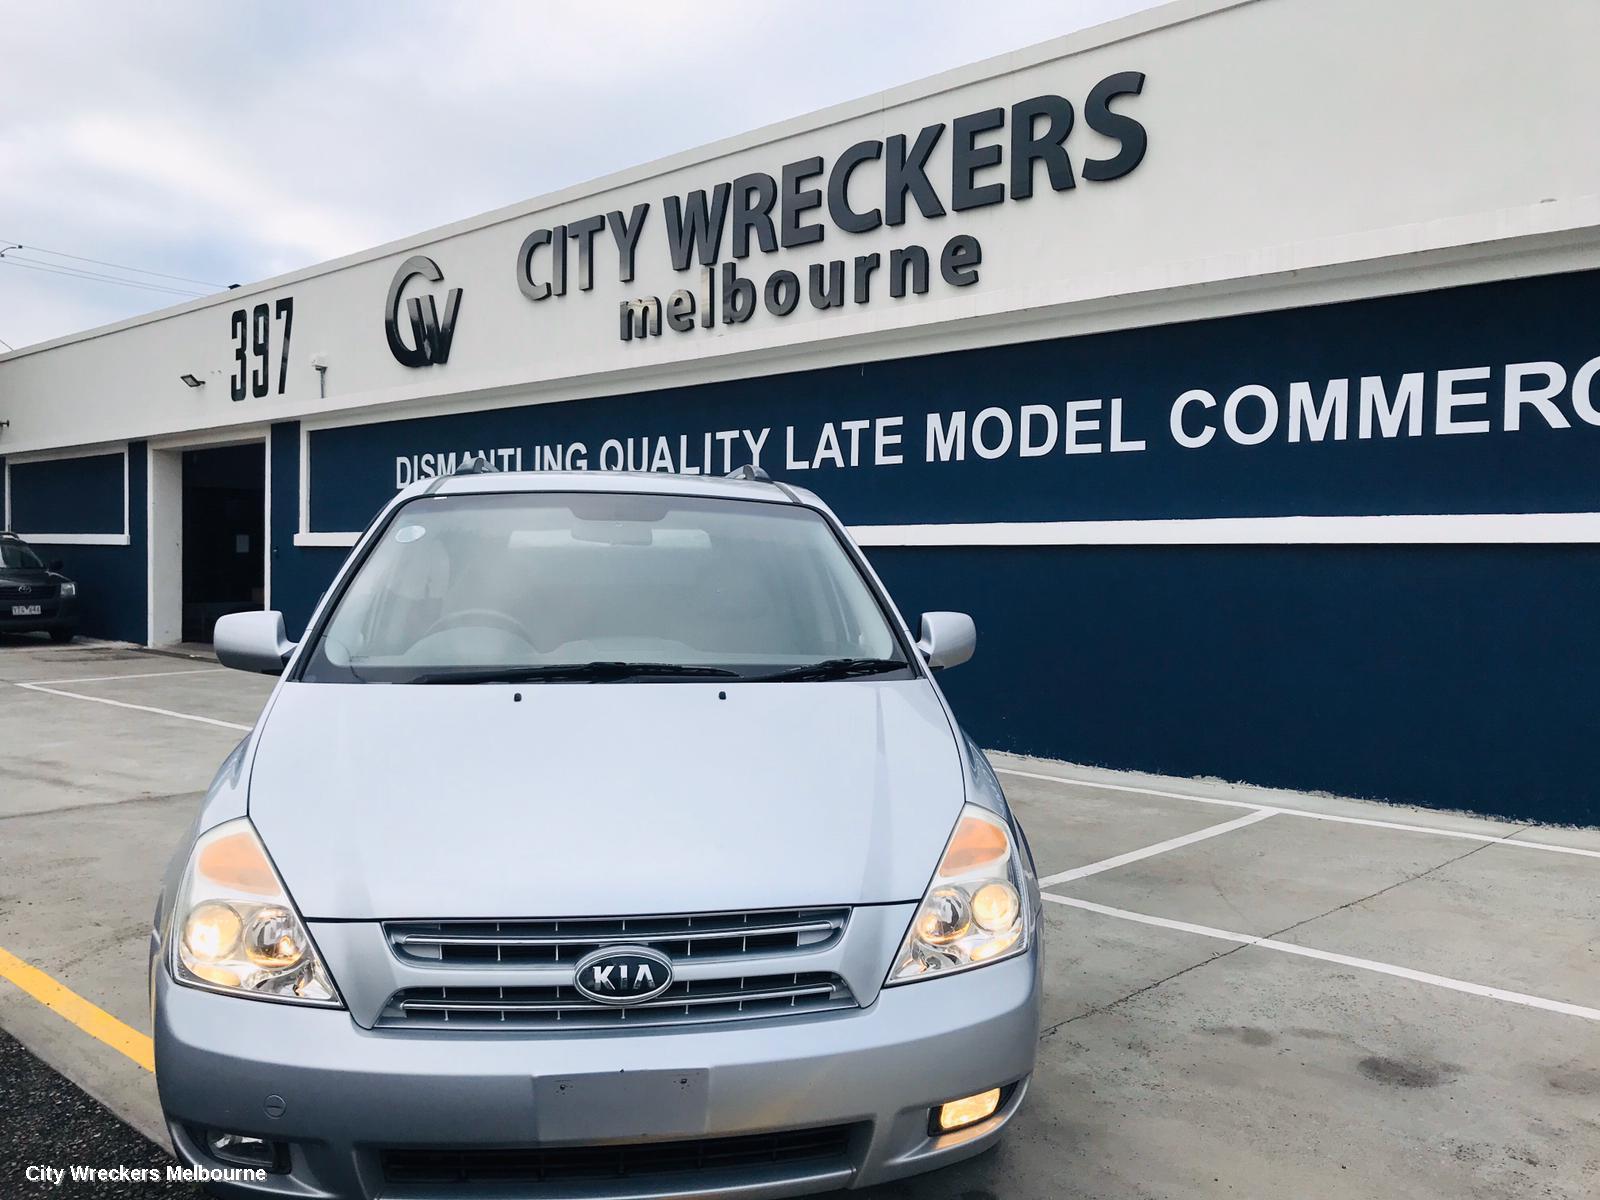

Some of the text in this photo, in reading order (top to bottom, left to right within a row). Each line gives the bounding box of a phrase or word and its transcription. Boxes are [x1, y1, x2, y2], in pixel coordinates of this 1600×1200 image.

[516, 71, 1148, 301] CITY WRECKERS
[619, 234, 983, 341] melbourne
[230, 297, 294, 401] 397
[600, 427, 771, 475] QUALITY
[785, 416, 905, 471] LATE
[925, 398, 1146, 464] MODEL
[593, 964, 656, 991] KIA
